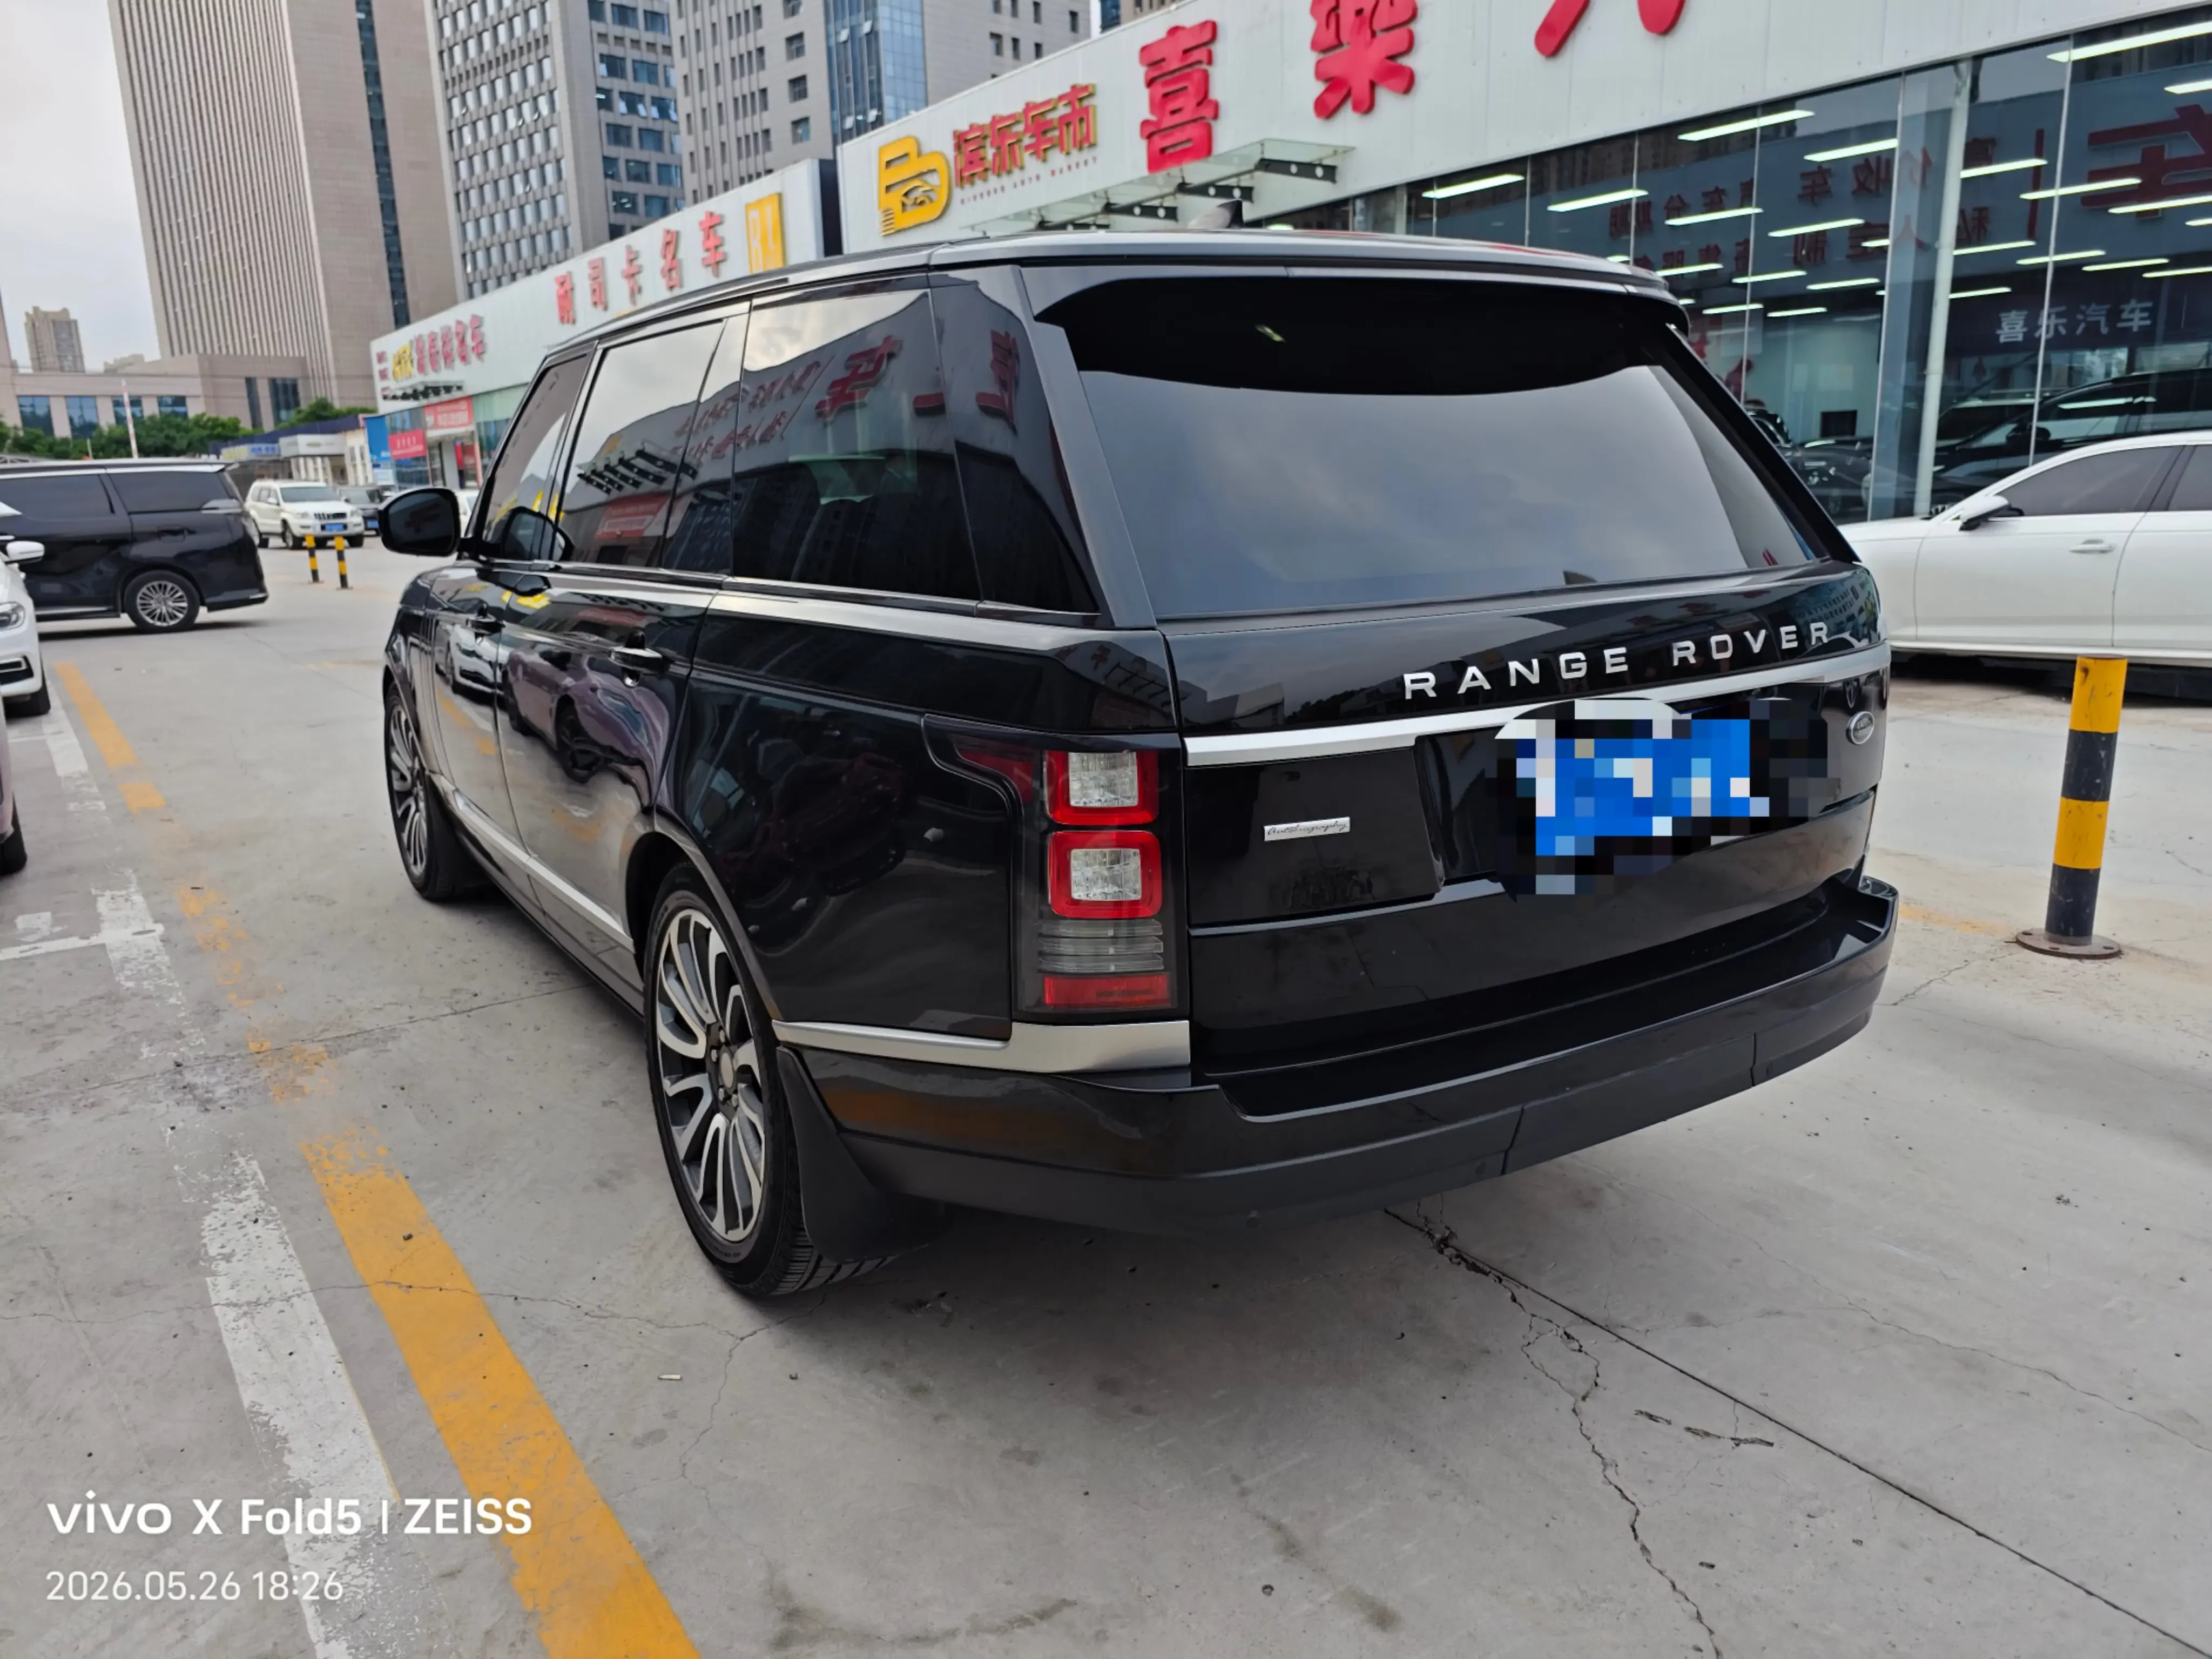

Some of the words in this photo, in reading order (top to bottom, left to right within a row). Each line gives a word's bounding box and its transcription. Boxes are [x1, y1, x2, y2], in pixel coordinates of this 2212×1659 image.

[953, 83, 1097, 189] 滨东车市
[1995, 298, 2154, 344] 喜乐汽车
[1404, 648, 1629, 700] RANGE
[1673, 622, 1829, 666] ROVER
